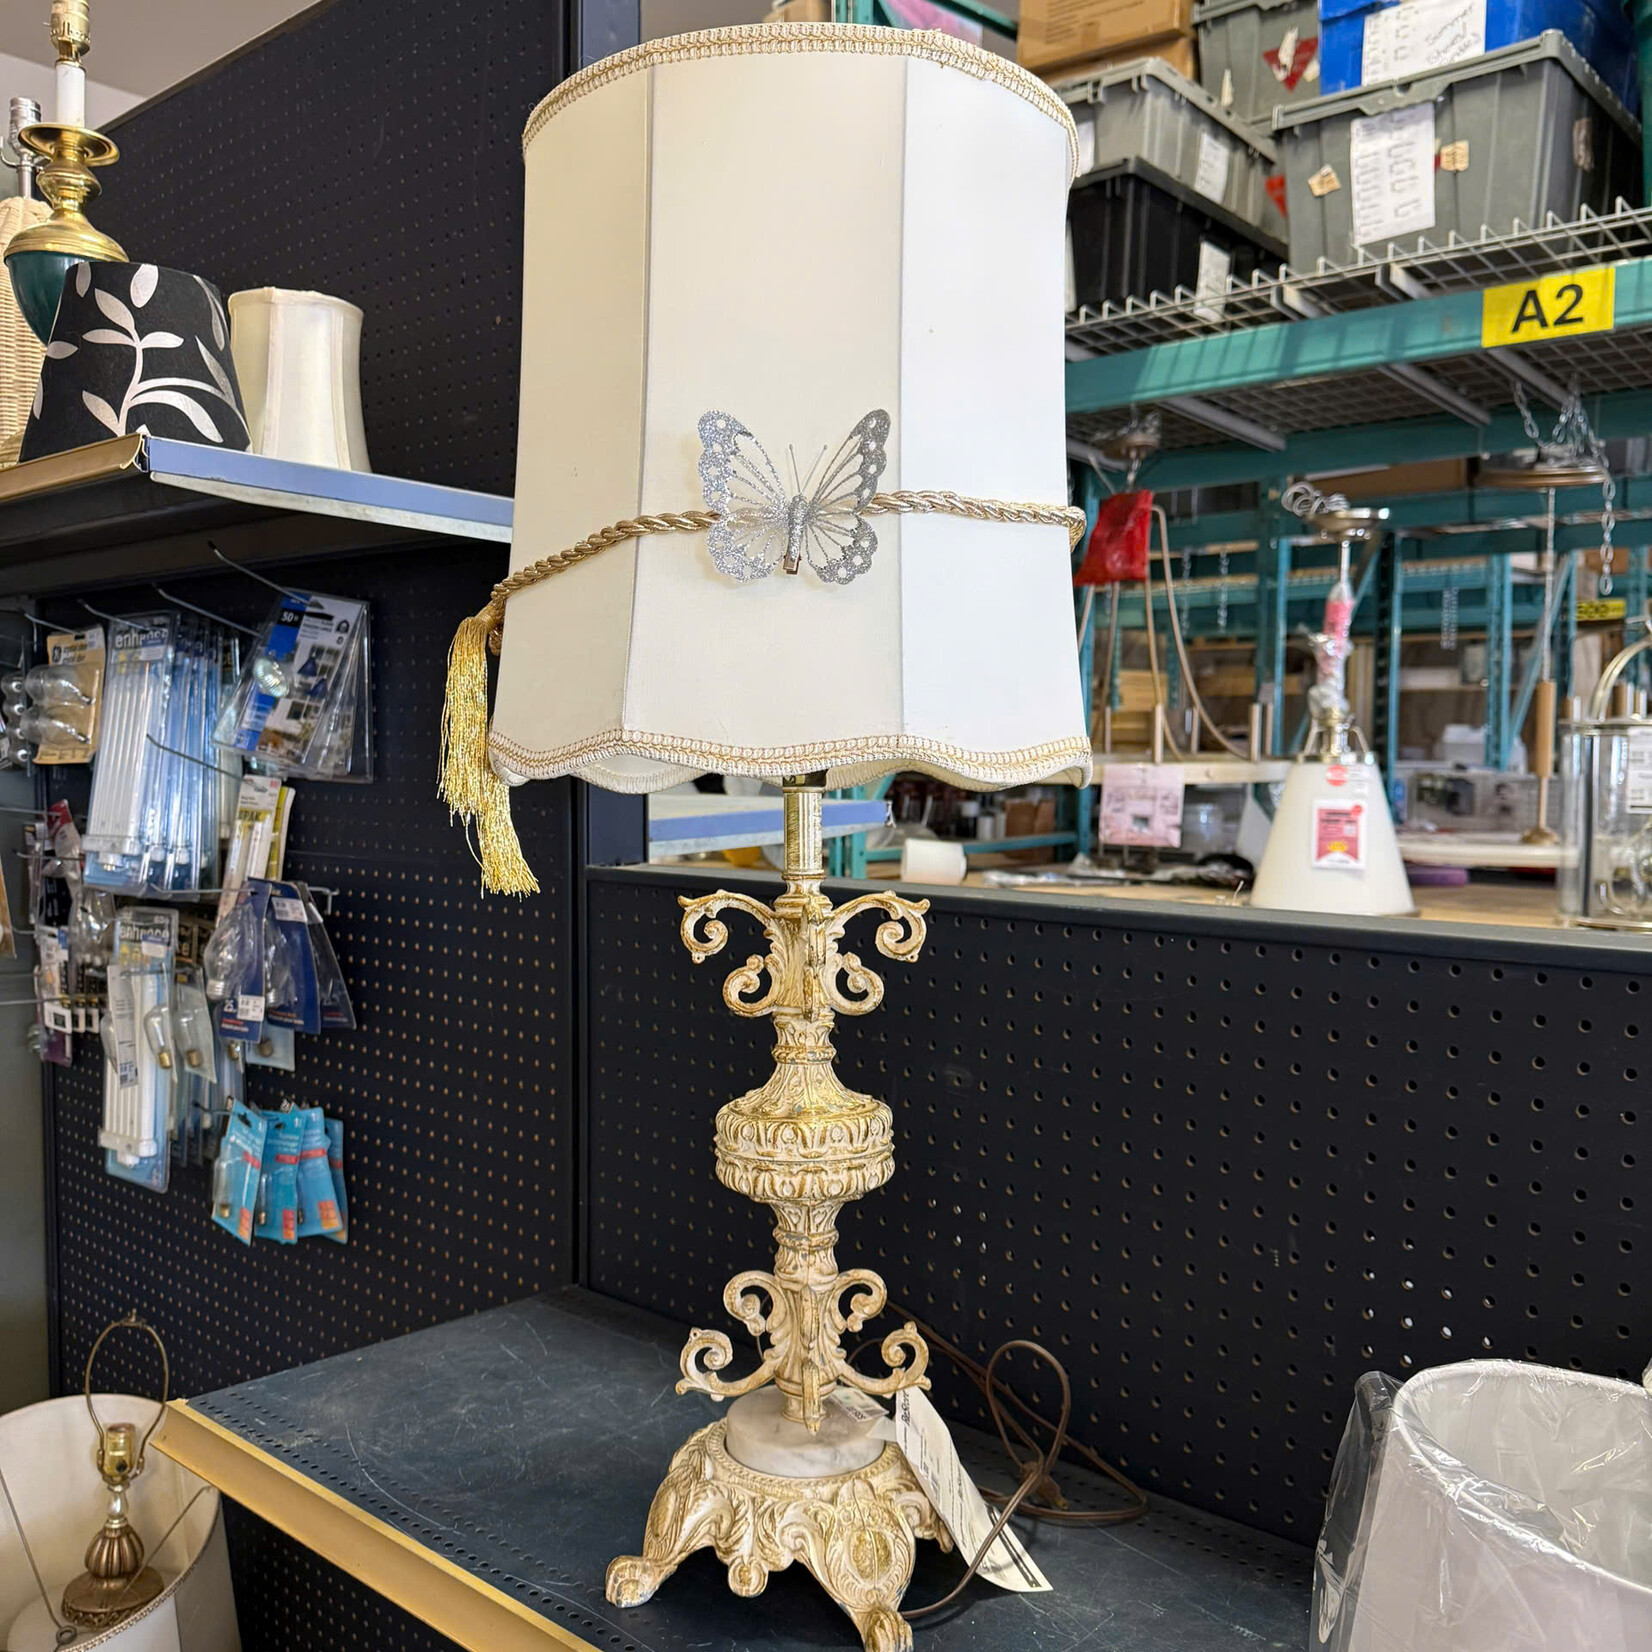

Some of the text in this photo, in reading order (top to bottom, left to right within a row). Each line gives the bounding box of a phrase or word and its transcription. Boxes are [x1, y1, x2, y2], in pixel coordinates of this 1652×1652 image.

[1511, 283, 1584, 333] A2
[281, 611, 294, 623] 50
[902, 1390, 912, 1426] ReStor
